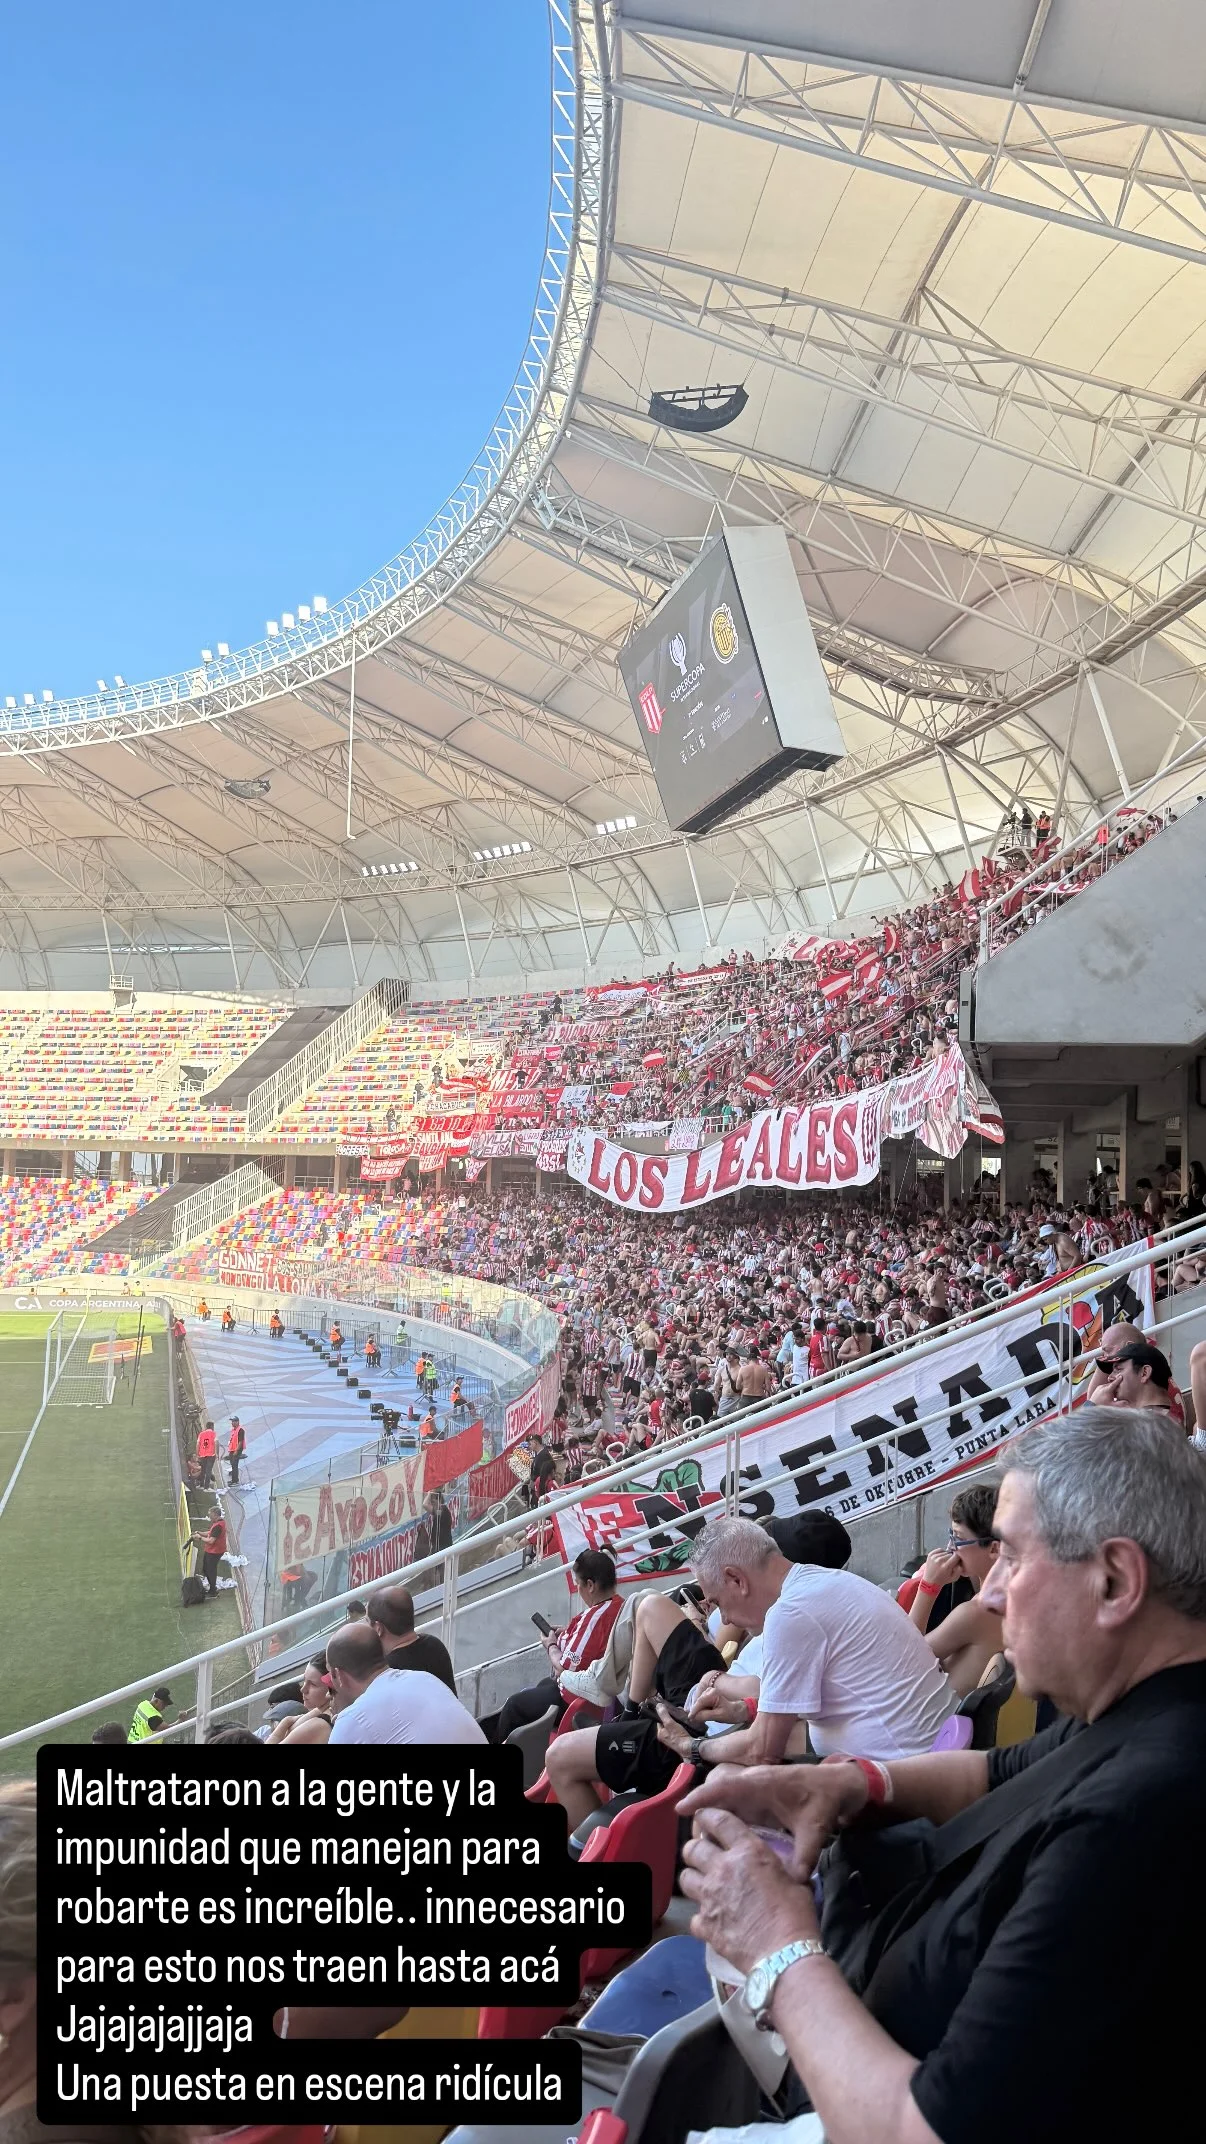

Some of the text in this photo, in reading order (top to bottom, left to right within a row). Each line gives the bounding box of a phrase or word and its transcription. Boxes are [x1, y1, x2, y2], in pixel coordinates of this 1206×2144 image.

[670, 662, 706, 703] SUPERCOPA
[587, 1138, 669, 1209] LOS
[680, 1102, 859, 1205] LEALES
[219, 1249, 274, 1272] GONNET
[49, 1299, 79, 1308] COPA
[80, 1299, 140, 1309] ARGENTINA
[839, 1494, 861, 1514] DE
[865, 1460, 936, 1502] OKTUBRE
[954, 1422, 1010, 1460] PUNTA
[1014, 1396, 1057, 1428] LARA
